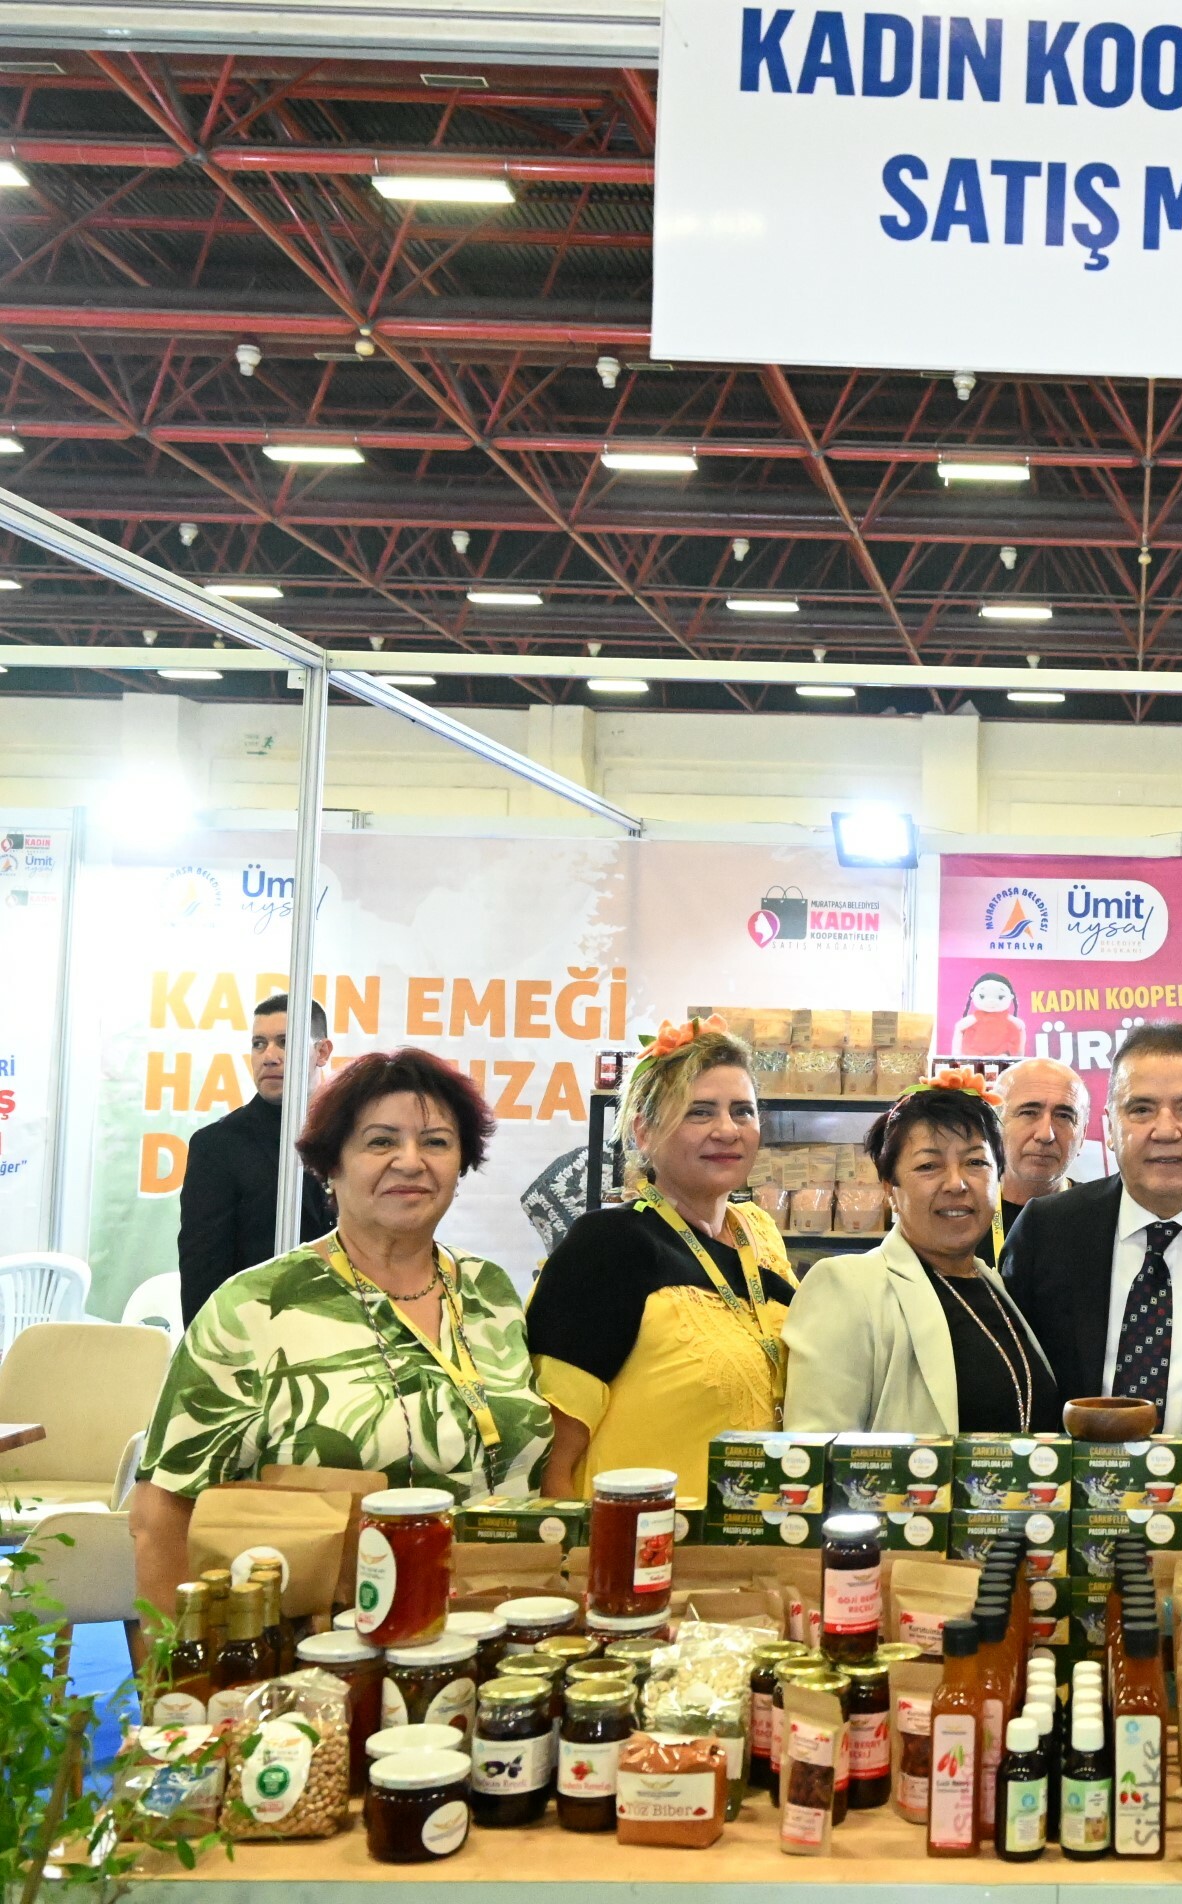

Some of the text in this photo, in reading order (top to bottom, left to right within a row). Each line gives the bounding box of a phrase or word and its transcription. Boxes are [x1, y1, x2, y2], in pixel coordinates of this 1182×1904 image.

[739, 7, 1004, 104] KADIN
[878, 152, 1121, 273] SATIŞ
[242, 863, 295, 898] Üm
[810, 900, 847, 910] MURATPAŞA
[986, 887, 1020, 930] MURATPAŞA
[1067, 884, 1145, 920] Ümit
[810, 911, 880, 931] KADIN
[1067, 906, 1155, 956] uysal
[989, 941, 1043, 951] ANTALYA
[405, 965, 629, 1042] EMEĞİ
[1030, 988, 1100, 1014] KADIN
[680, 1229, 703, 1254] YOREX
[718, 1285, 740, 1310] YOREX
[751, 1277, 766, 1305] YOREX
[460, 1384, 484, 1410] YOREX
[1134, 1740, 1160, 1847] Sirke
[652, 1804, 693, 1817] Biber
